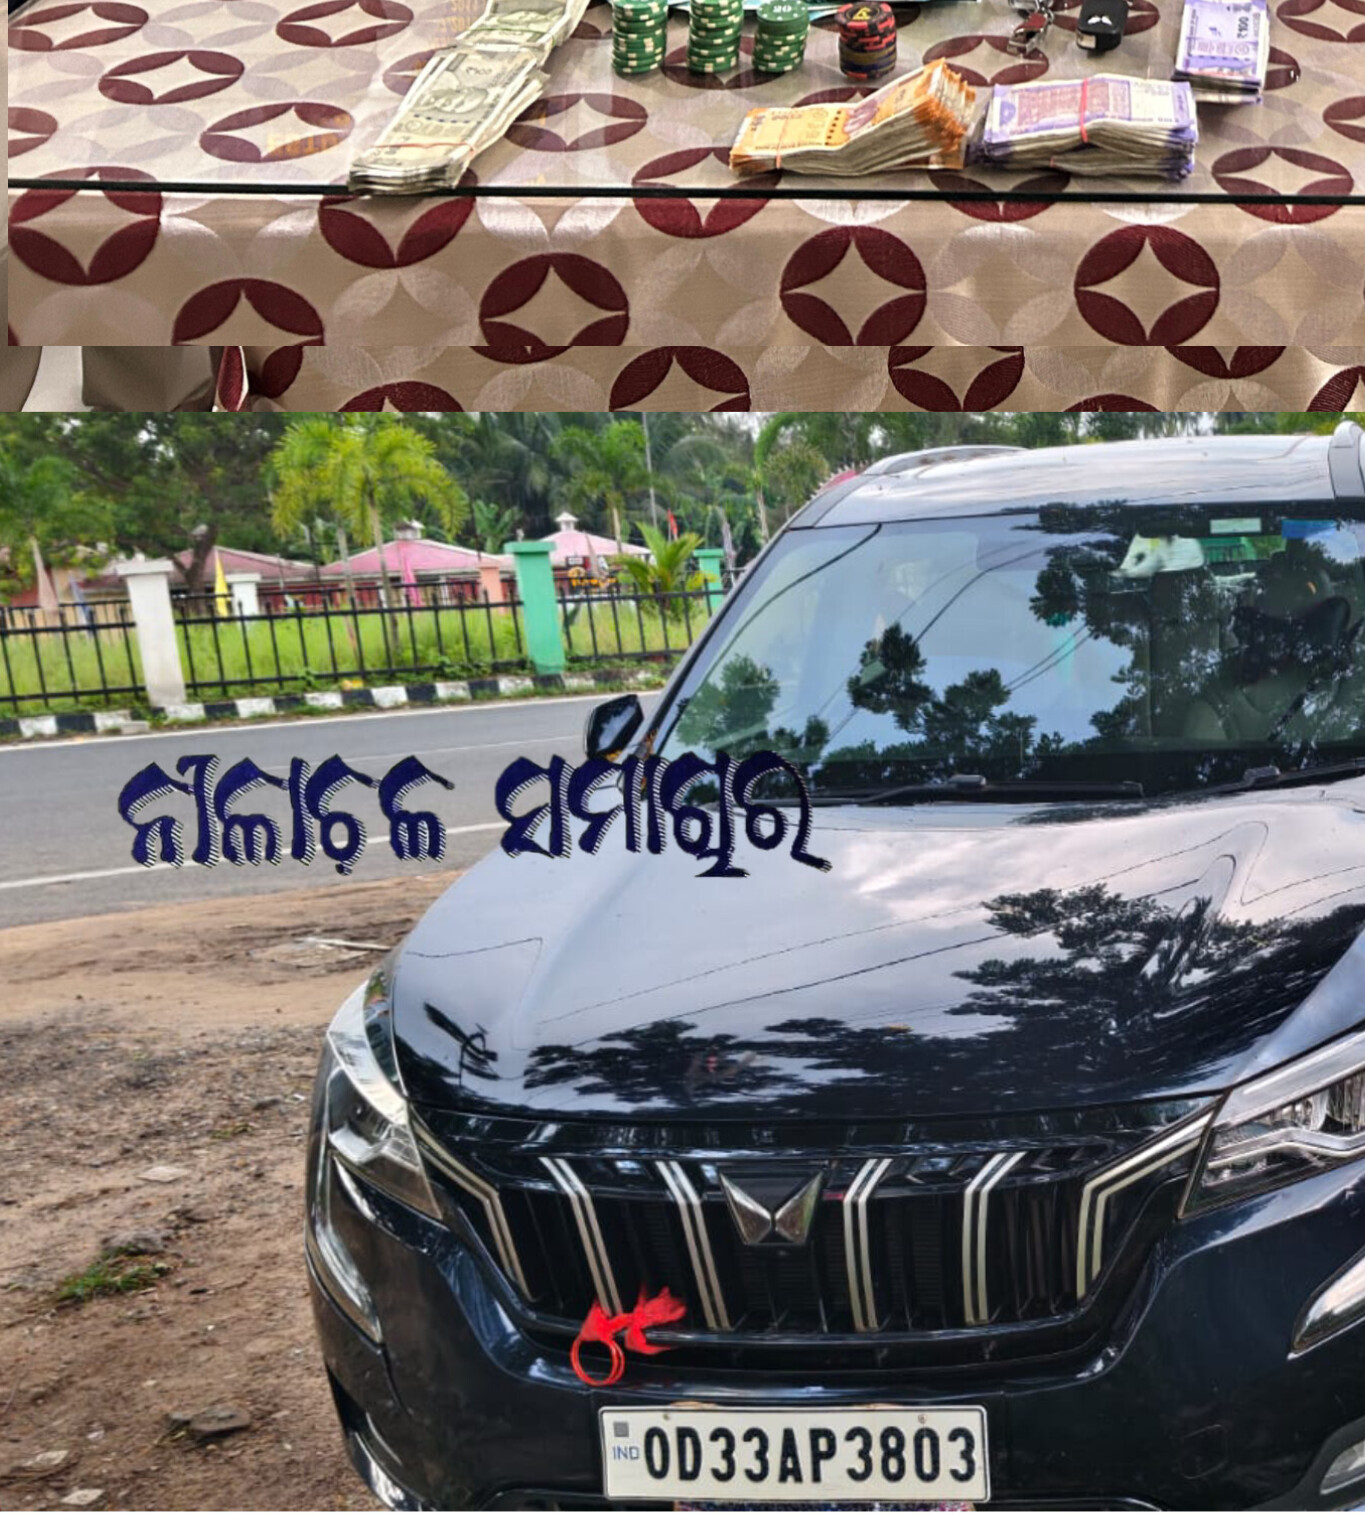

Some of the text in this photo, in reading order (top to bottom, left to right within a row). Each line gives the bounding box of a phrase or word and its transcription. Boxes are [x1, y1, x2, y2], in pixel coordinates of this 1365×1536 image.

[771, 4, 793, 13] 20
[612, 1445, 640, 1461] IND
[643, 1426, 976, 1483] OD33AP3803
